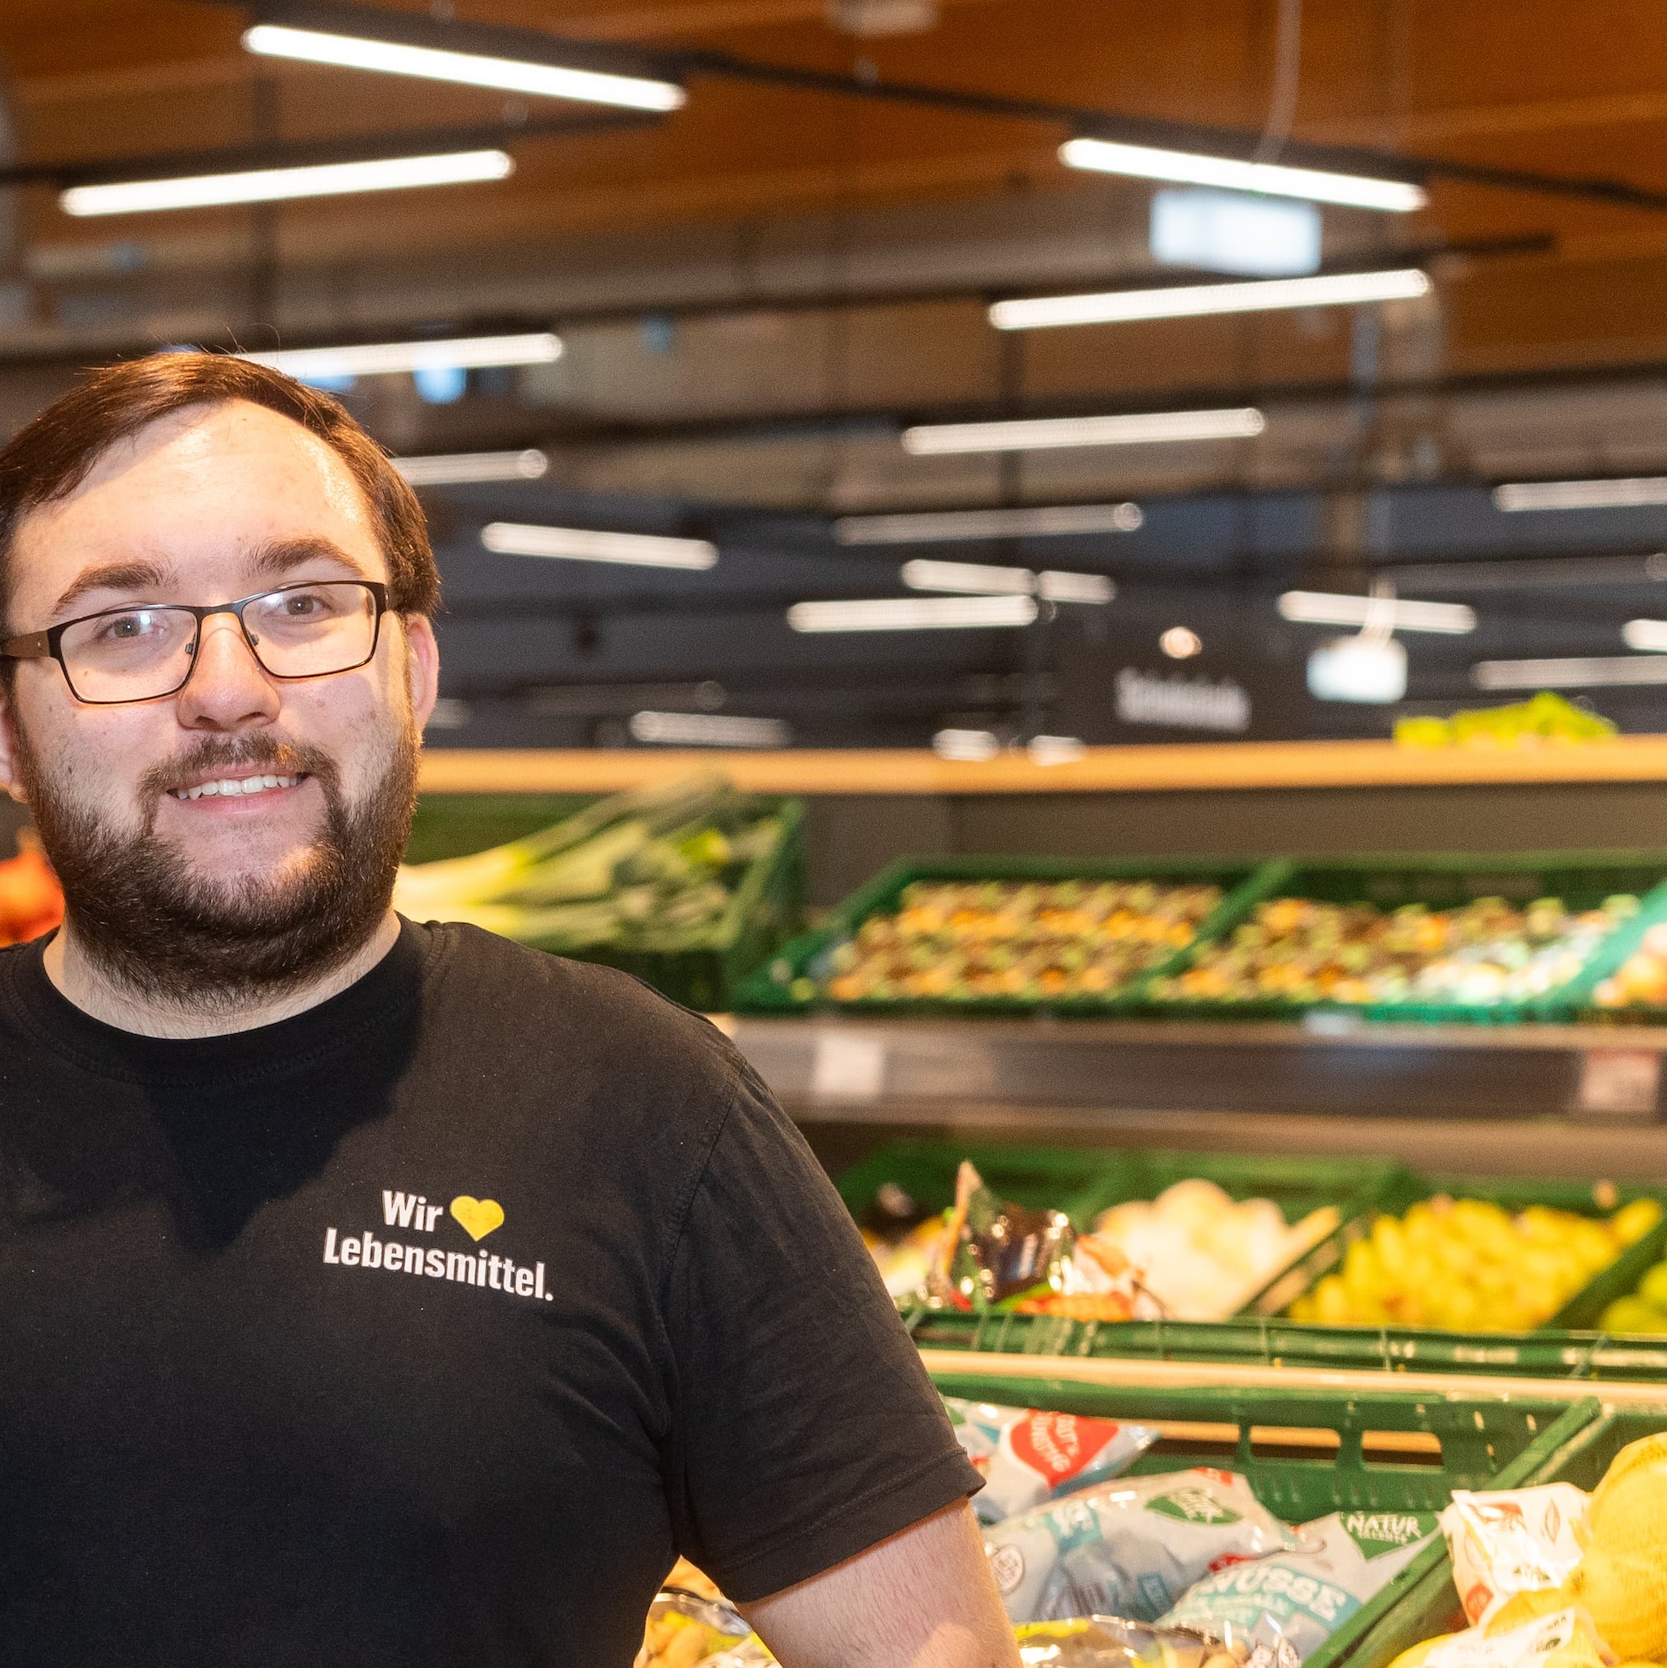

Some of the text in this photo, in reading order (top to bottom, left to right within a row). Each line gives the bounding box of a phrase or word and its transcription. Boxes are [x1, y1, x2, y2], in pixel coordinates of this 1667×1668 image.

[382, 1190, 443, 1232] Wir
[323, 1227, 554, 1301] Lebensmittel.
[1347, 1515, 1422, 1538] NATUR
